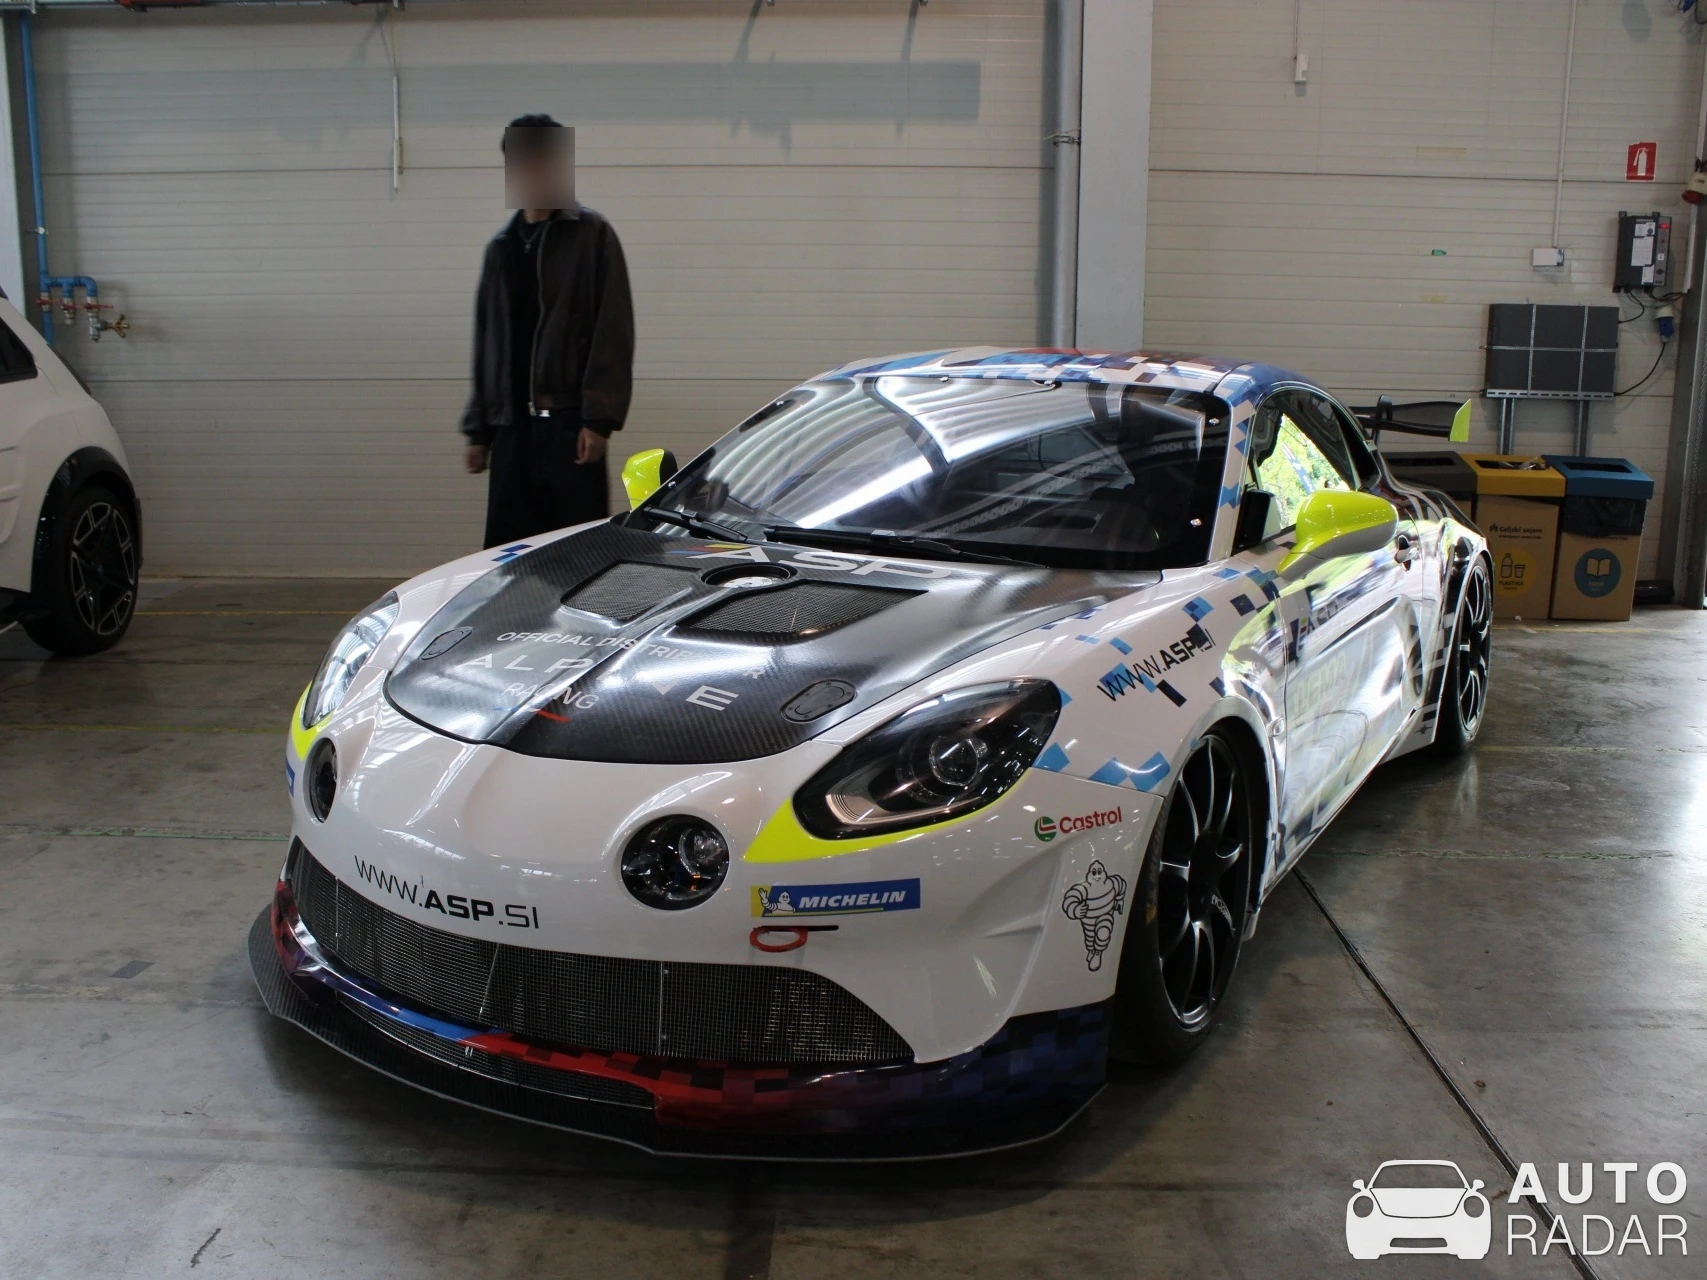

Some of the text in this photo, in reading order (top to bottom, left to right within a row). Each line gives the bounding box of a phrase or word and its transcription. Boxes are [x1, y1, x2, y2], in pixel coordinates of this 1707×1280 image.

[686, 546, 951, 579] ASP
[496, 631, 594, 646] OFFICIAL
[454, 653, 740, 712] ALPE
[501, 683, 600, 709] RACNG
[1059, 806, 1123, 834] Castrol
[354, 855, 540, 929] WWW.ASP.SI
[798, 890, 907, 909] MICHELIN
